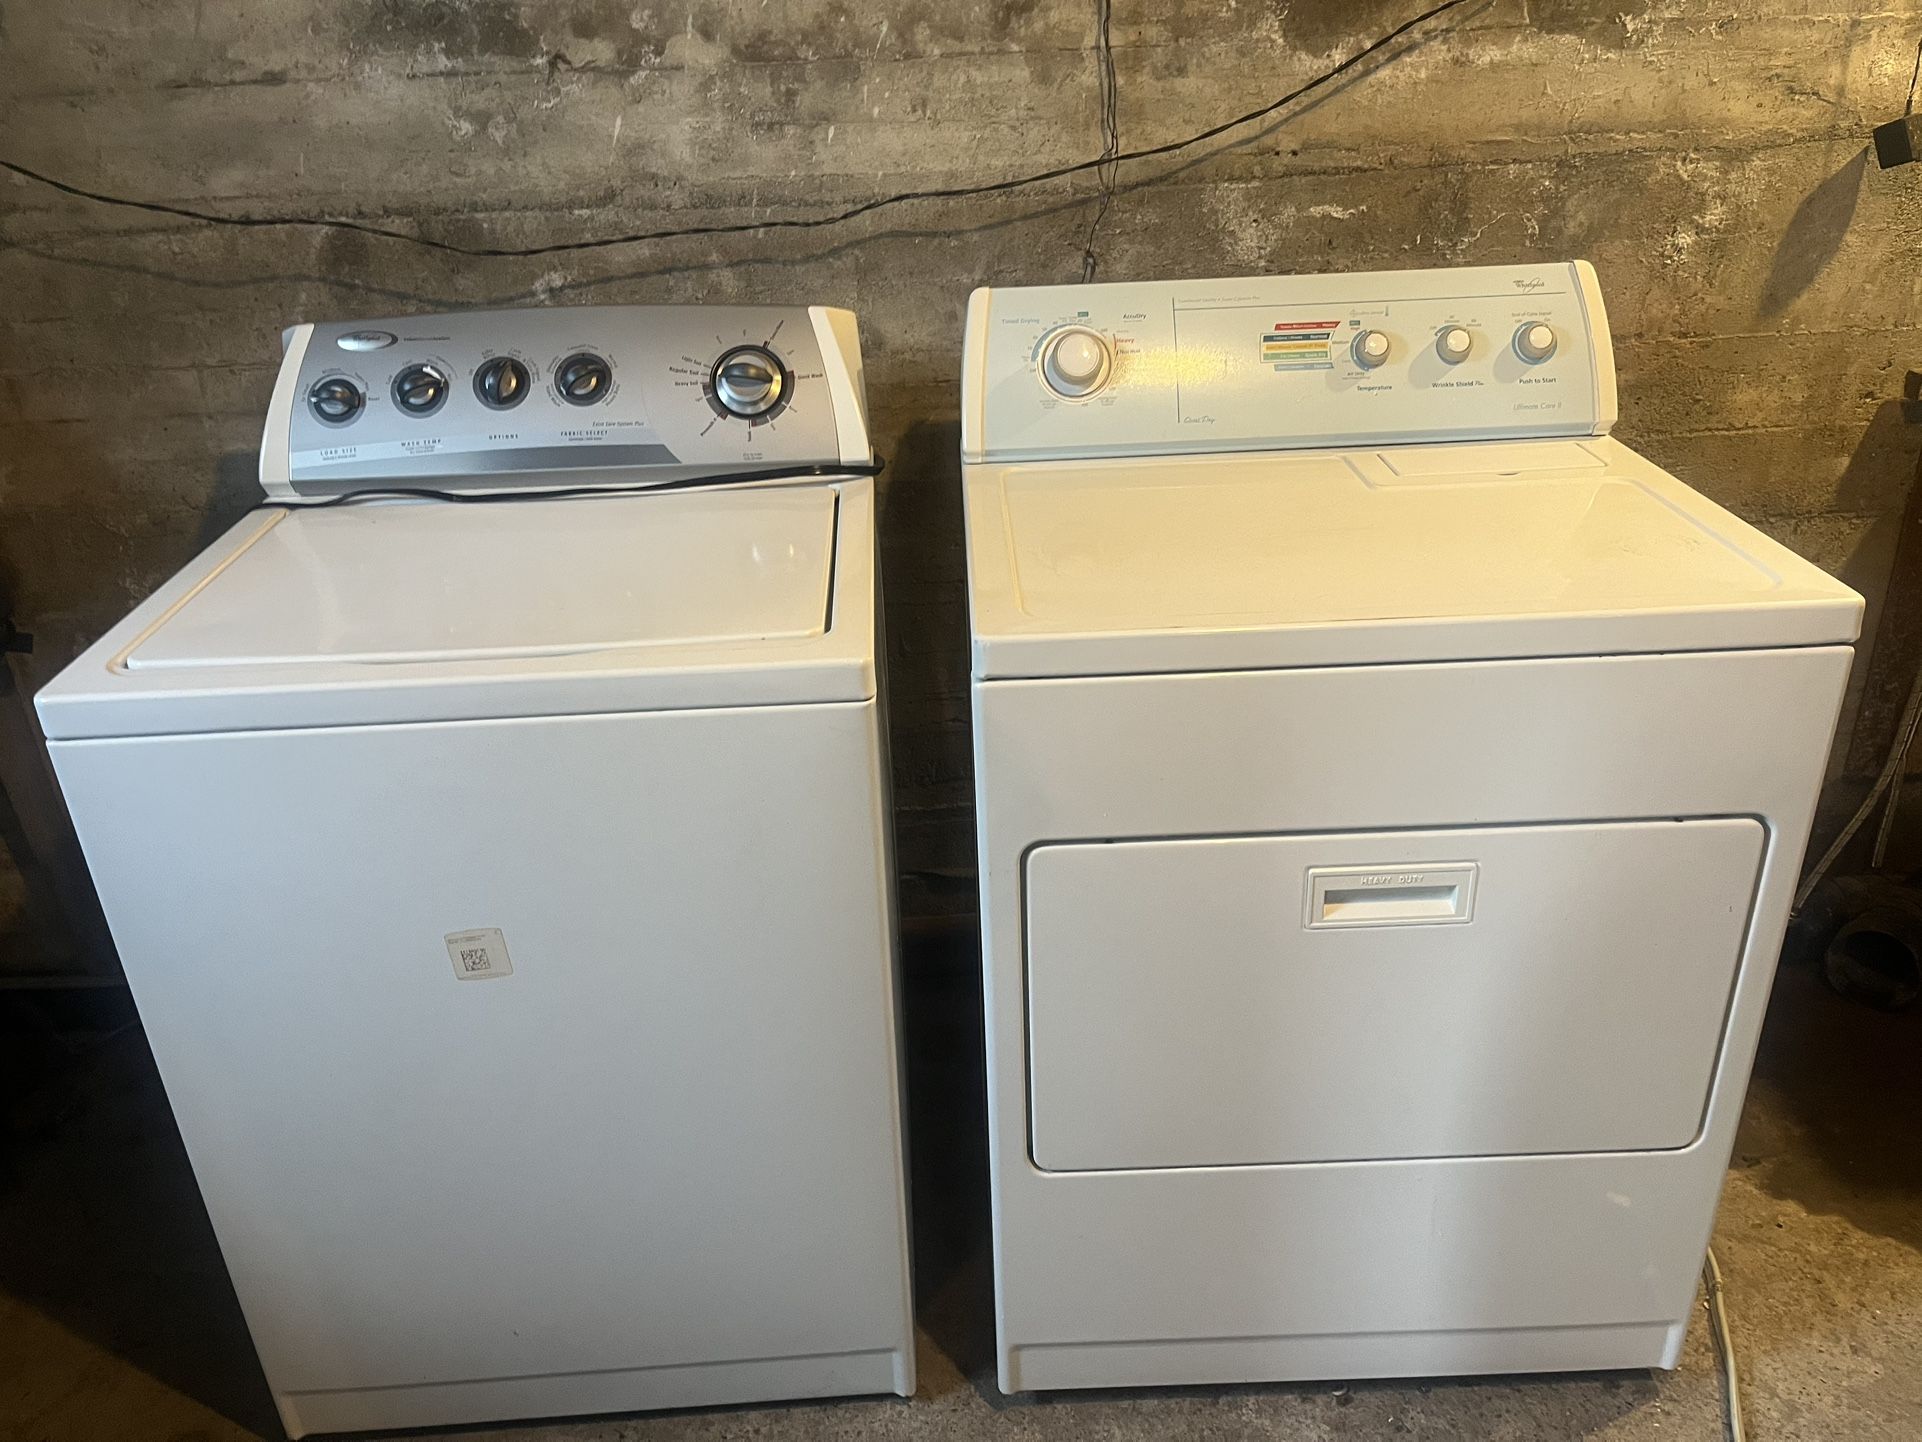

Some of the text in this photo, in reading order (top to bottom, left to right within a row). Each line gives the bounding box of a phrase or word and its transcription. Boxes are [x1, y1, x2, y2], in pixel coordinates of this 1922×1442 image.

[320, 449, 338, 457] LOAD
[1361, 873, 1424, 885] HEAVY DUTY
